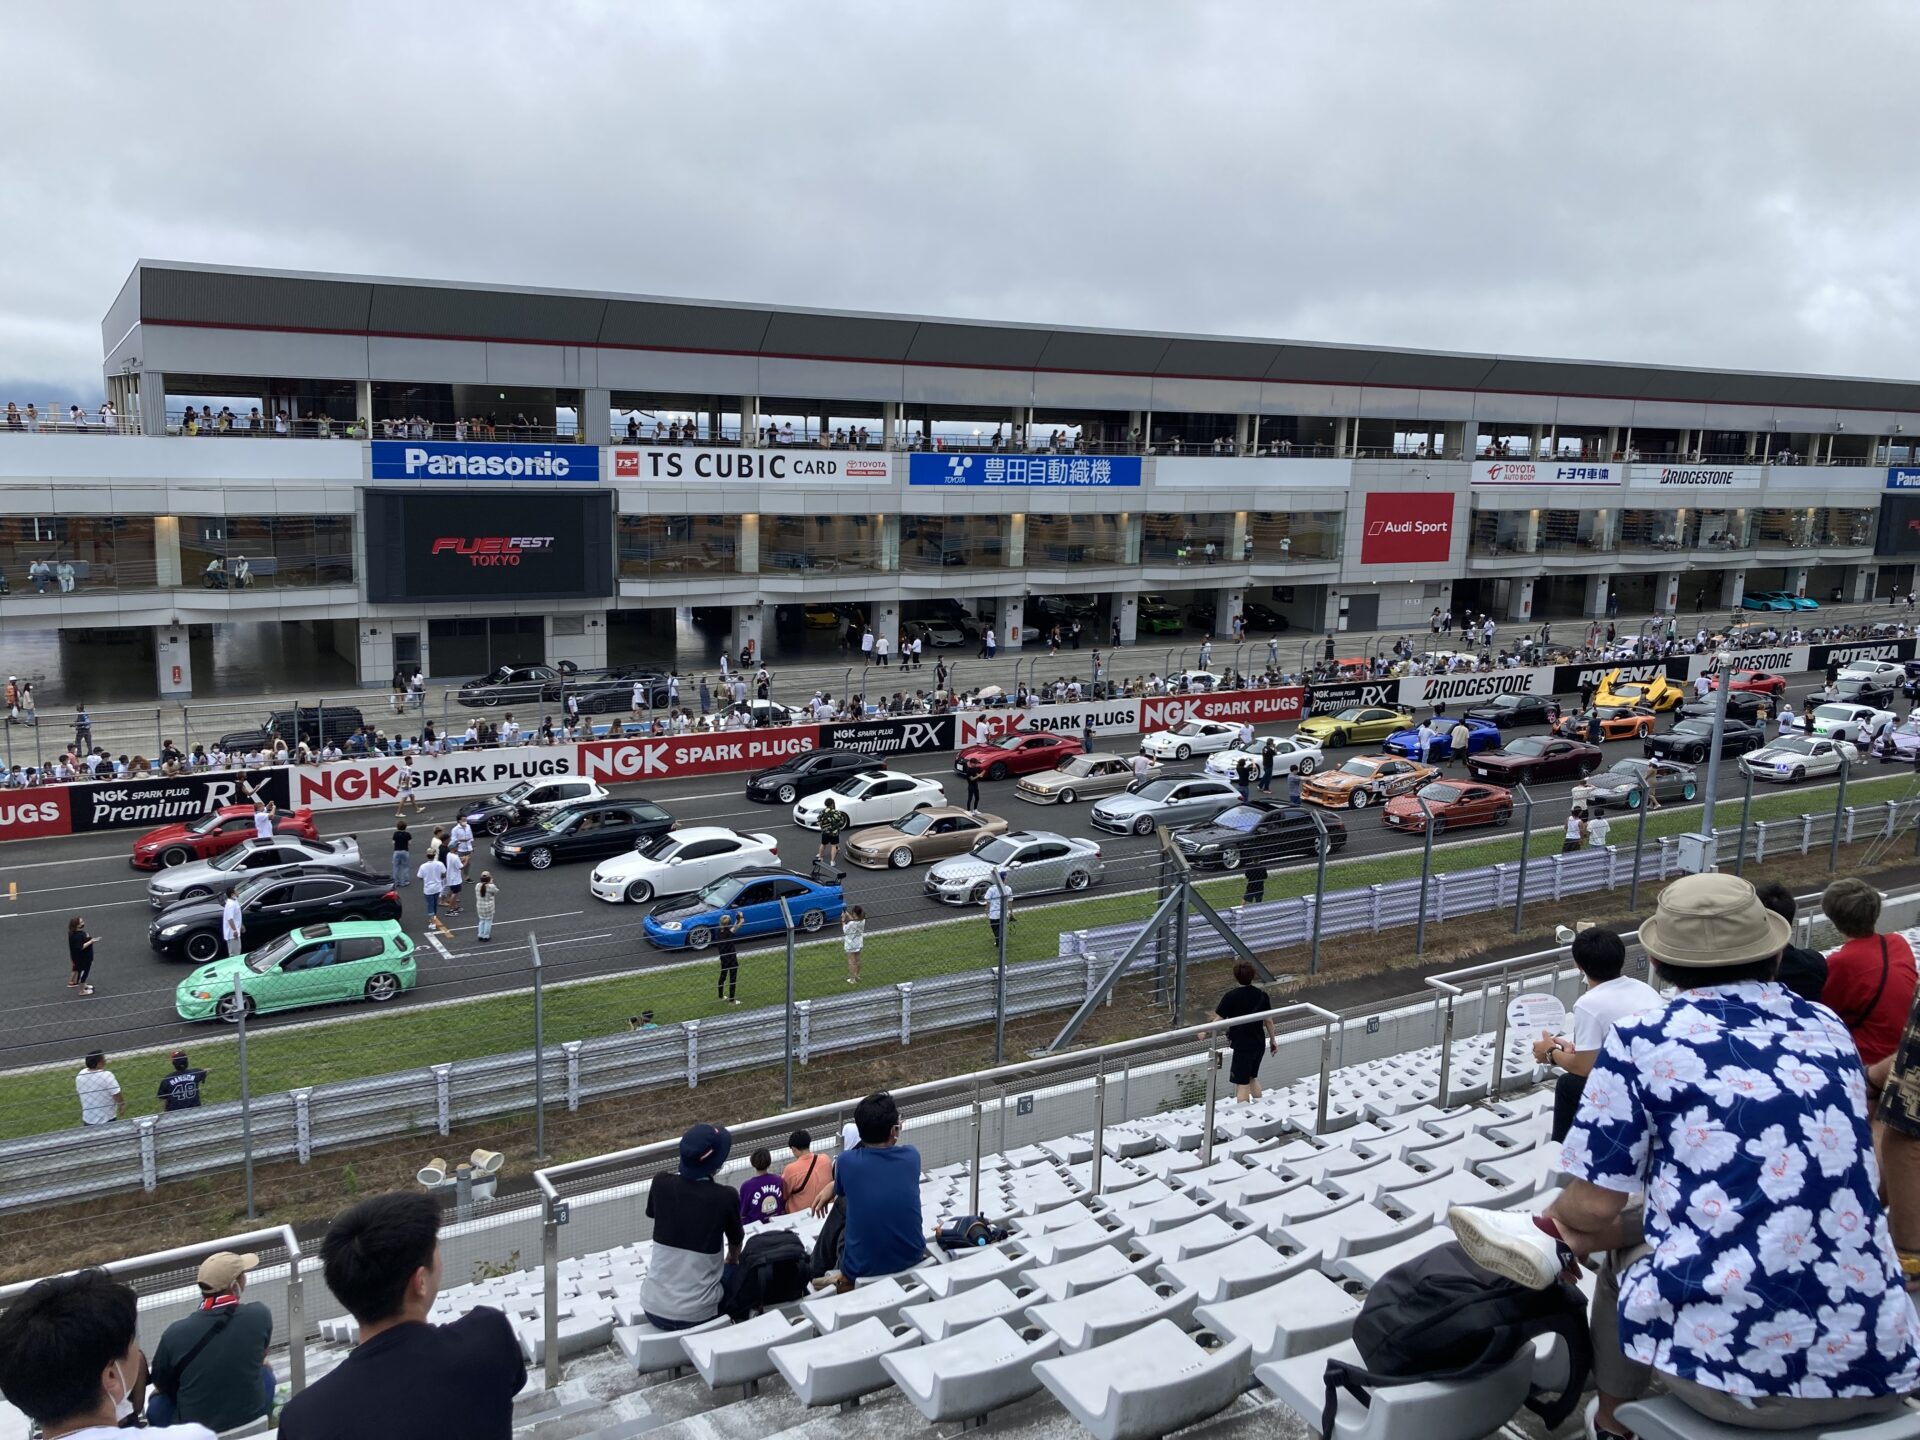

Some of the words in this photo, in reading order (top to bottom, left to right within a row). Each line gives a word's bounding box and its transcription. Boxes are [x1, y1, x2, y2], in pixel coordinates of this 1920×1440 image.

[404, 448, 570, 477] Panasonic
[647, 452, 683, 478] TS
[694, 453, 786, 479] CUBIC
[793, 460, 837, 475] CARD
[983, 457, 1112, 484] 豊田自動織機
[1504, 464, 1536, 474] TOYOTA
[1503, 473, 1519, 481] AUTO
[1519, 473, 1536, 481] BODY
[1556, 467, 1610, 480] トヨタ車体
[1659, 468, 1734, 485] BRIDGESTONE
[1384, 521, 1412, 533] Audi
[1414, 521, 1448, 535] Sport
[469, 555, 521, 567] TOKYO
[1826, 645, 1899, 665] POTENZA
[1313, 690, 1330, 698] NGK
[1422, 673, 1534, 700] BRIDGESTONE
[1311, 697, 1360, 712] Premium
[1360, 684, 1393, 706] RX
[1144, 698, 1201, 728] NGK
[1204, 701, 1251, 717] SPARK
[1254, 697, 1299, 713] PLUGS
[1029, 715, 1081, 731] SPARK
[833, 729, 856, 740] NGK
[857, 730, 877, 738] SPARK
[878, 728, 894, 736] PLUG
[900, 721, 946, 750] RX
[584, 742, 670, 777] NGK
[675, 743, 743, 765] SPARK
[749, 737, 813, 758] PLUGS
[299, 764, 399, 805] NGK
[411, 765, 486, 788] SPARK
[493, 758, 570, 780] PLUGS
[92, 789, 128, 804] NGK
[131, 789, 163, 800] SPARK
[164, 788, 190, 798] PLUG
[92, 799, 201, 824] Premium
[171, 1082, 197, 1101] 48
